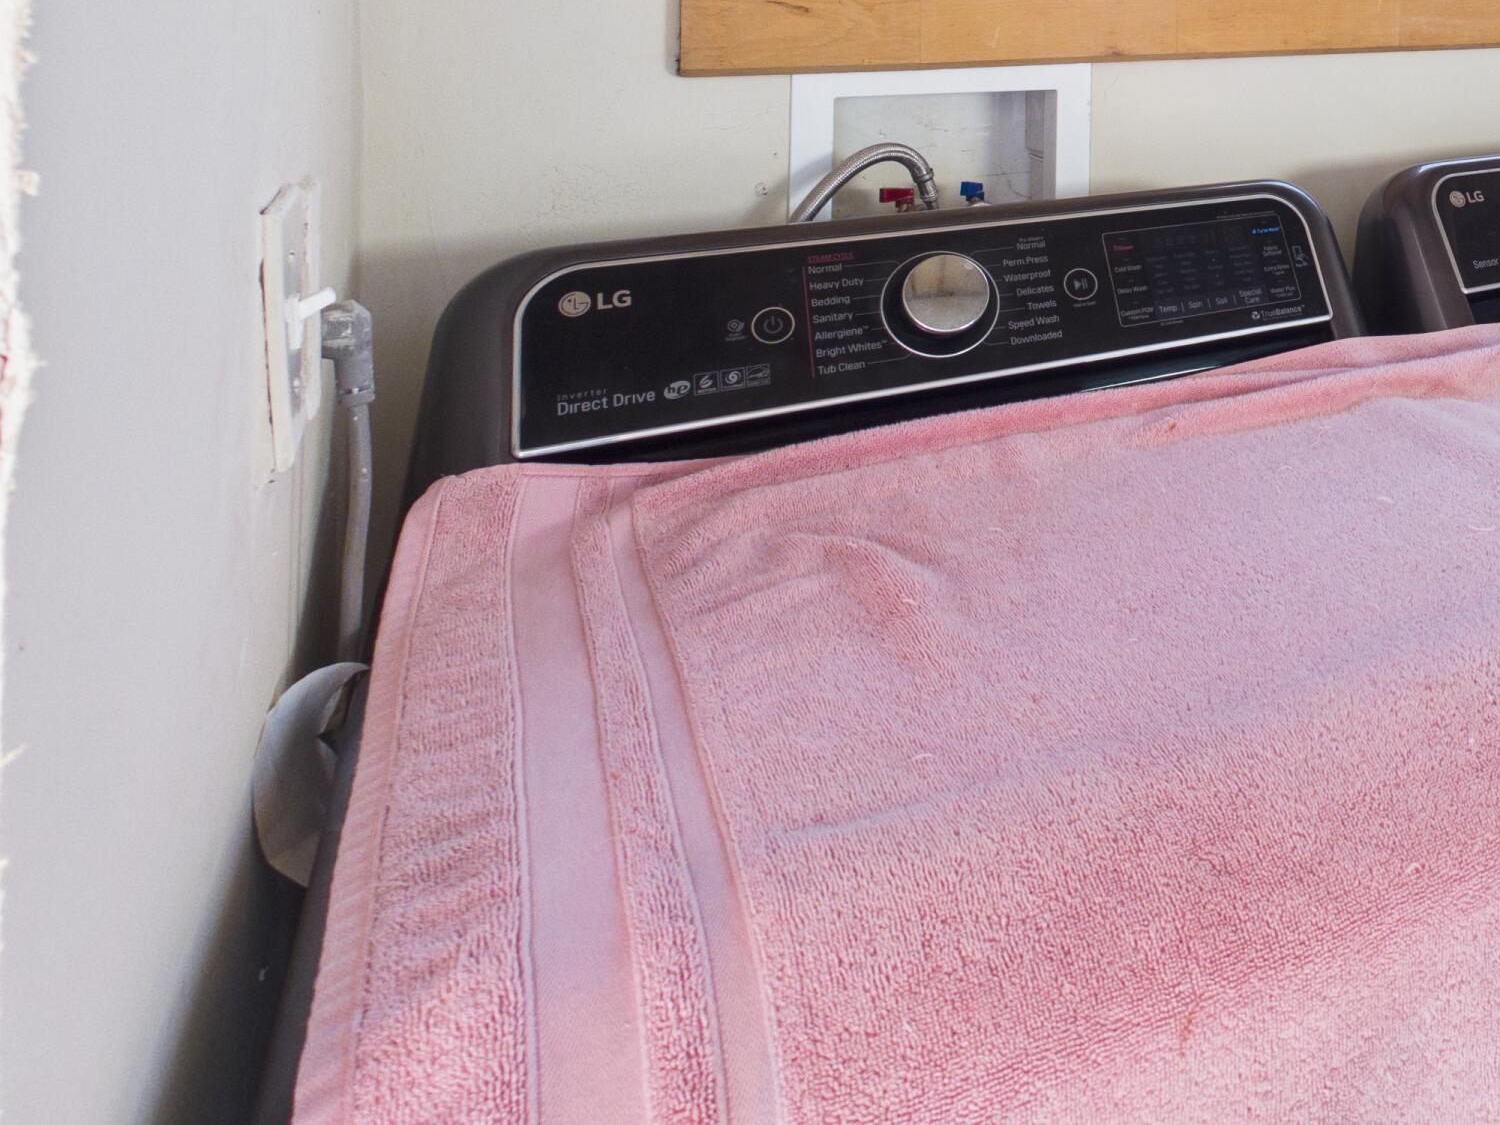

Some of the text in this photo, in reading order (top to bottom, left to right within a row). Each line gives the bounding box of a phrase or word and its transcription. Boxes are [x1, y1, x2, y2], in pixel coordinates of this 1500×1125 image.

[1466, 190, 1486, 204] LG
[1016, 240, 1046, 251] Normal
[808, 264, 843, 275] Normal
[1472, 257, 1500, 270] Sensor
[1003, 268, 1052, 283] Waterproof
[809, 278, 865, 292] Heavy Duty
[1016, 284, 1055, 297] Delicates
[1239, 288, 1263, 298] Special
[597, 289, 632, 311] LG
[811, 295, 851, 308] Bedding
[1027, 299, 1057, 311] Towels
[1187, 300, 1204, 309] Spin
[1215, 296, 1229, 306] Soil
[1244, 295, 1261, 305] Care
[1158, 303, 1179, 314] Temp
[812, 312, 854, 324] Sanitary
[1007, 314, 1060, 331] Speed Wash
[1009, 329, 1064, 346] Downloaded
[815, 345, 847, 359] Bright
[817, 359, 866, 376] Tub Clean
[556, 387, 609, 402] Inverter
[556, 396, 609, 417] Direct
[612, 389, 657, 408] Drive
